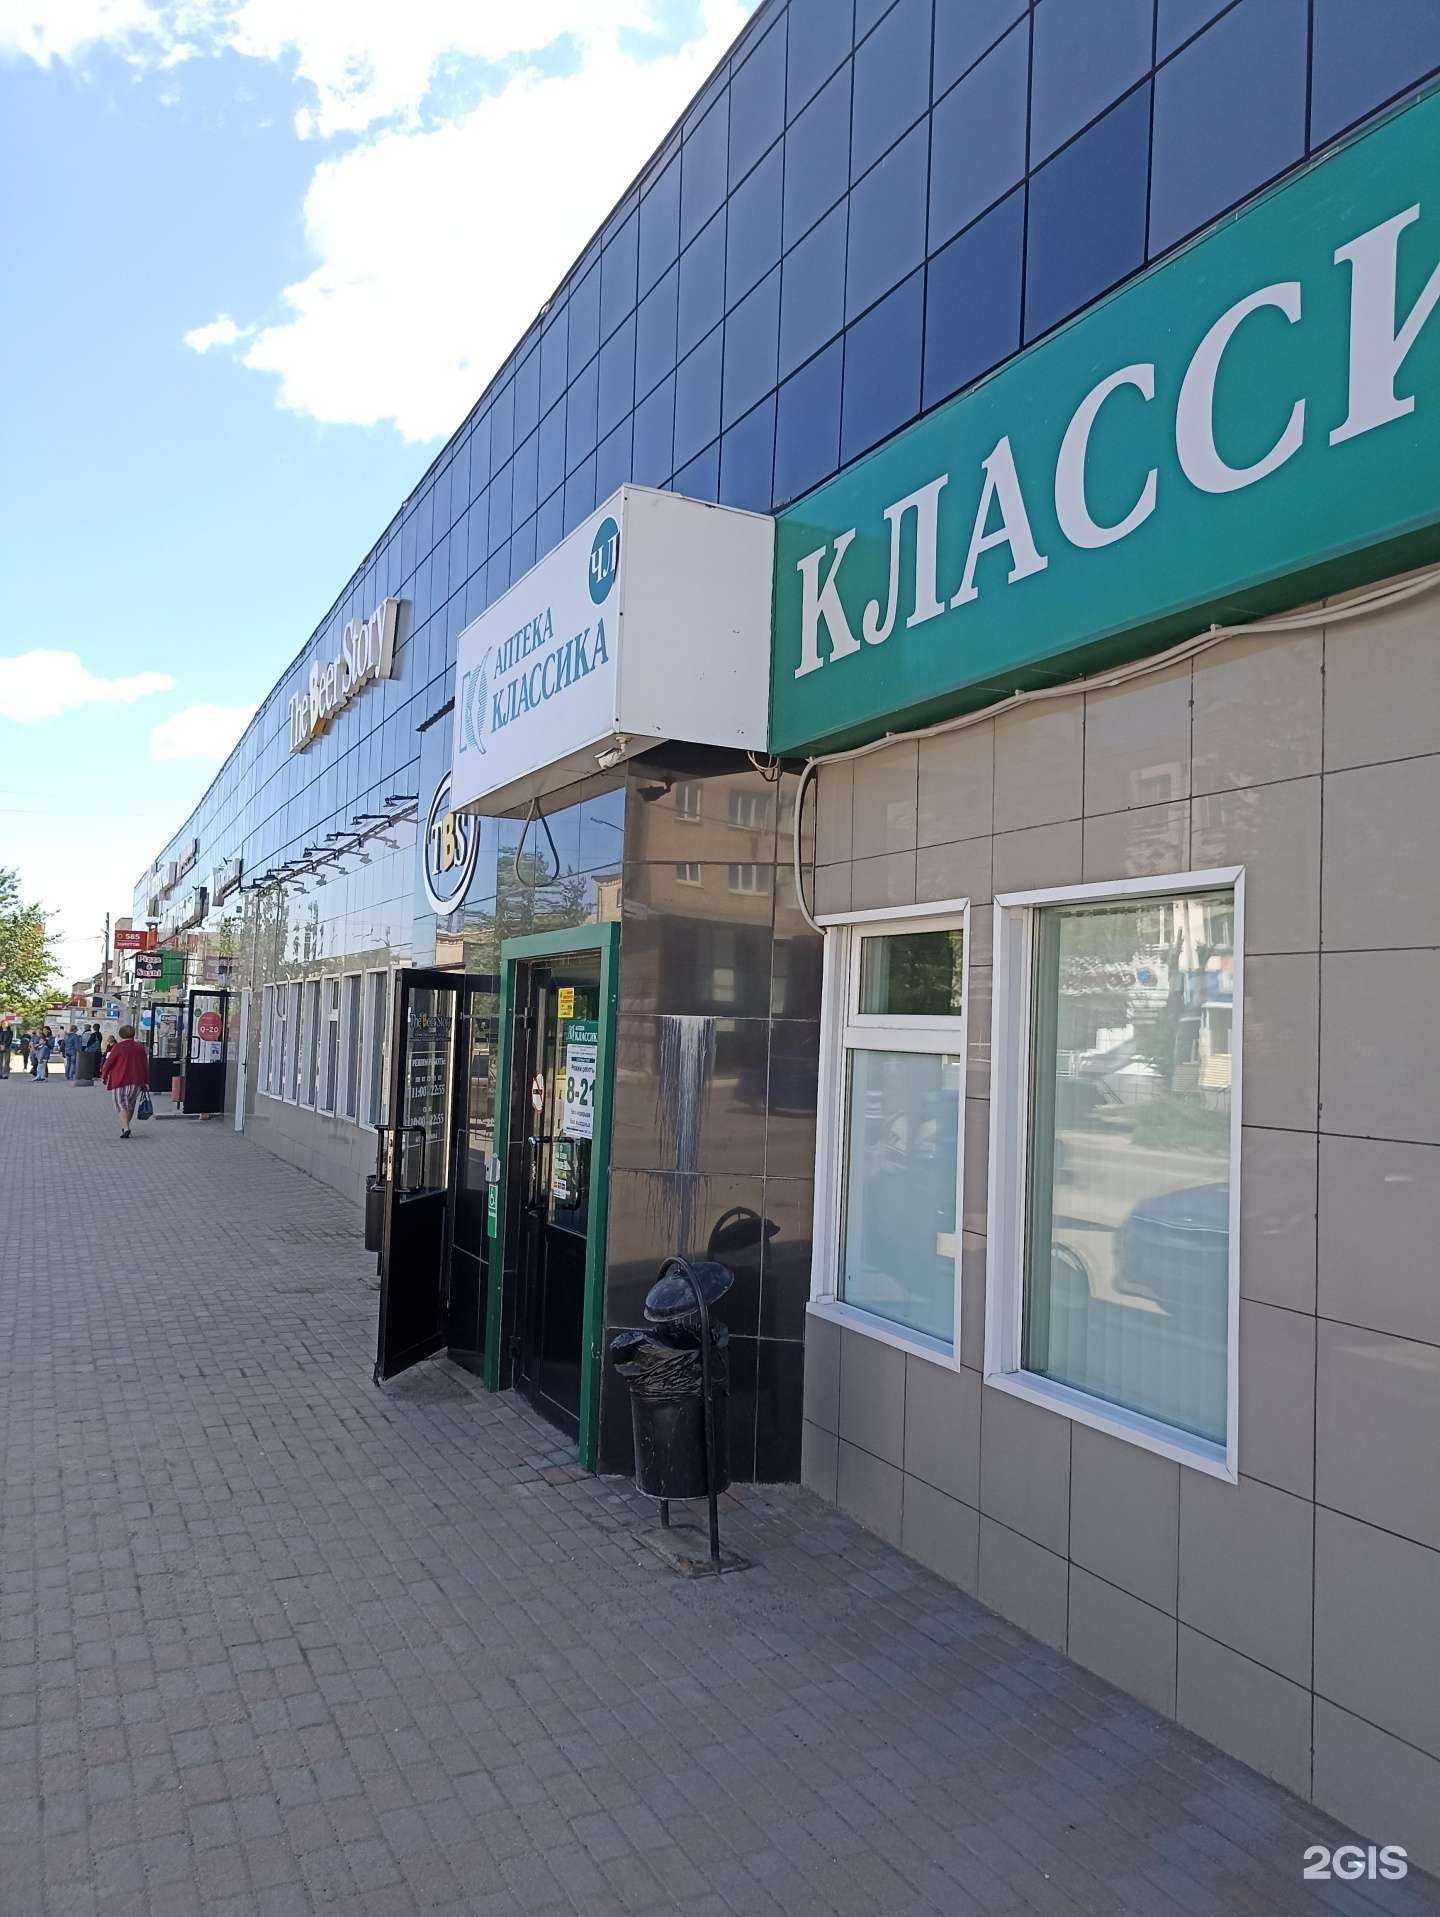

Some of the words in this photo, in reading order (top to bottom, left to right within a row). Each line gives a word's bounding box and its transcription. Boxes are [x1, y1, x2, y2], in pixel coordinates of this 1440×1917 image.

[309, 657, 340, 735] Beer
[342, 599, 392, 694] Story
[491, 617, 609, 734] КЛАССИКА
[494, 607, 554, 680] АПТЕКА
[431, 812, 468, 876] TBS
